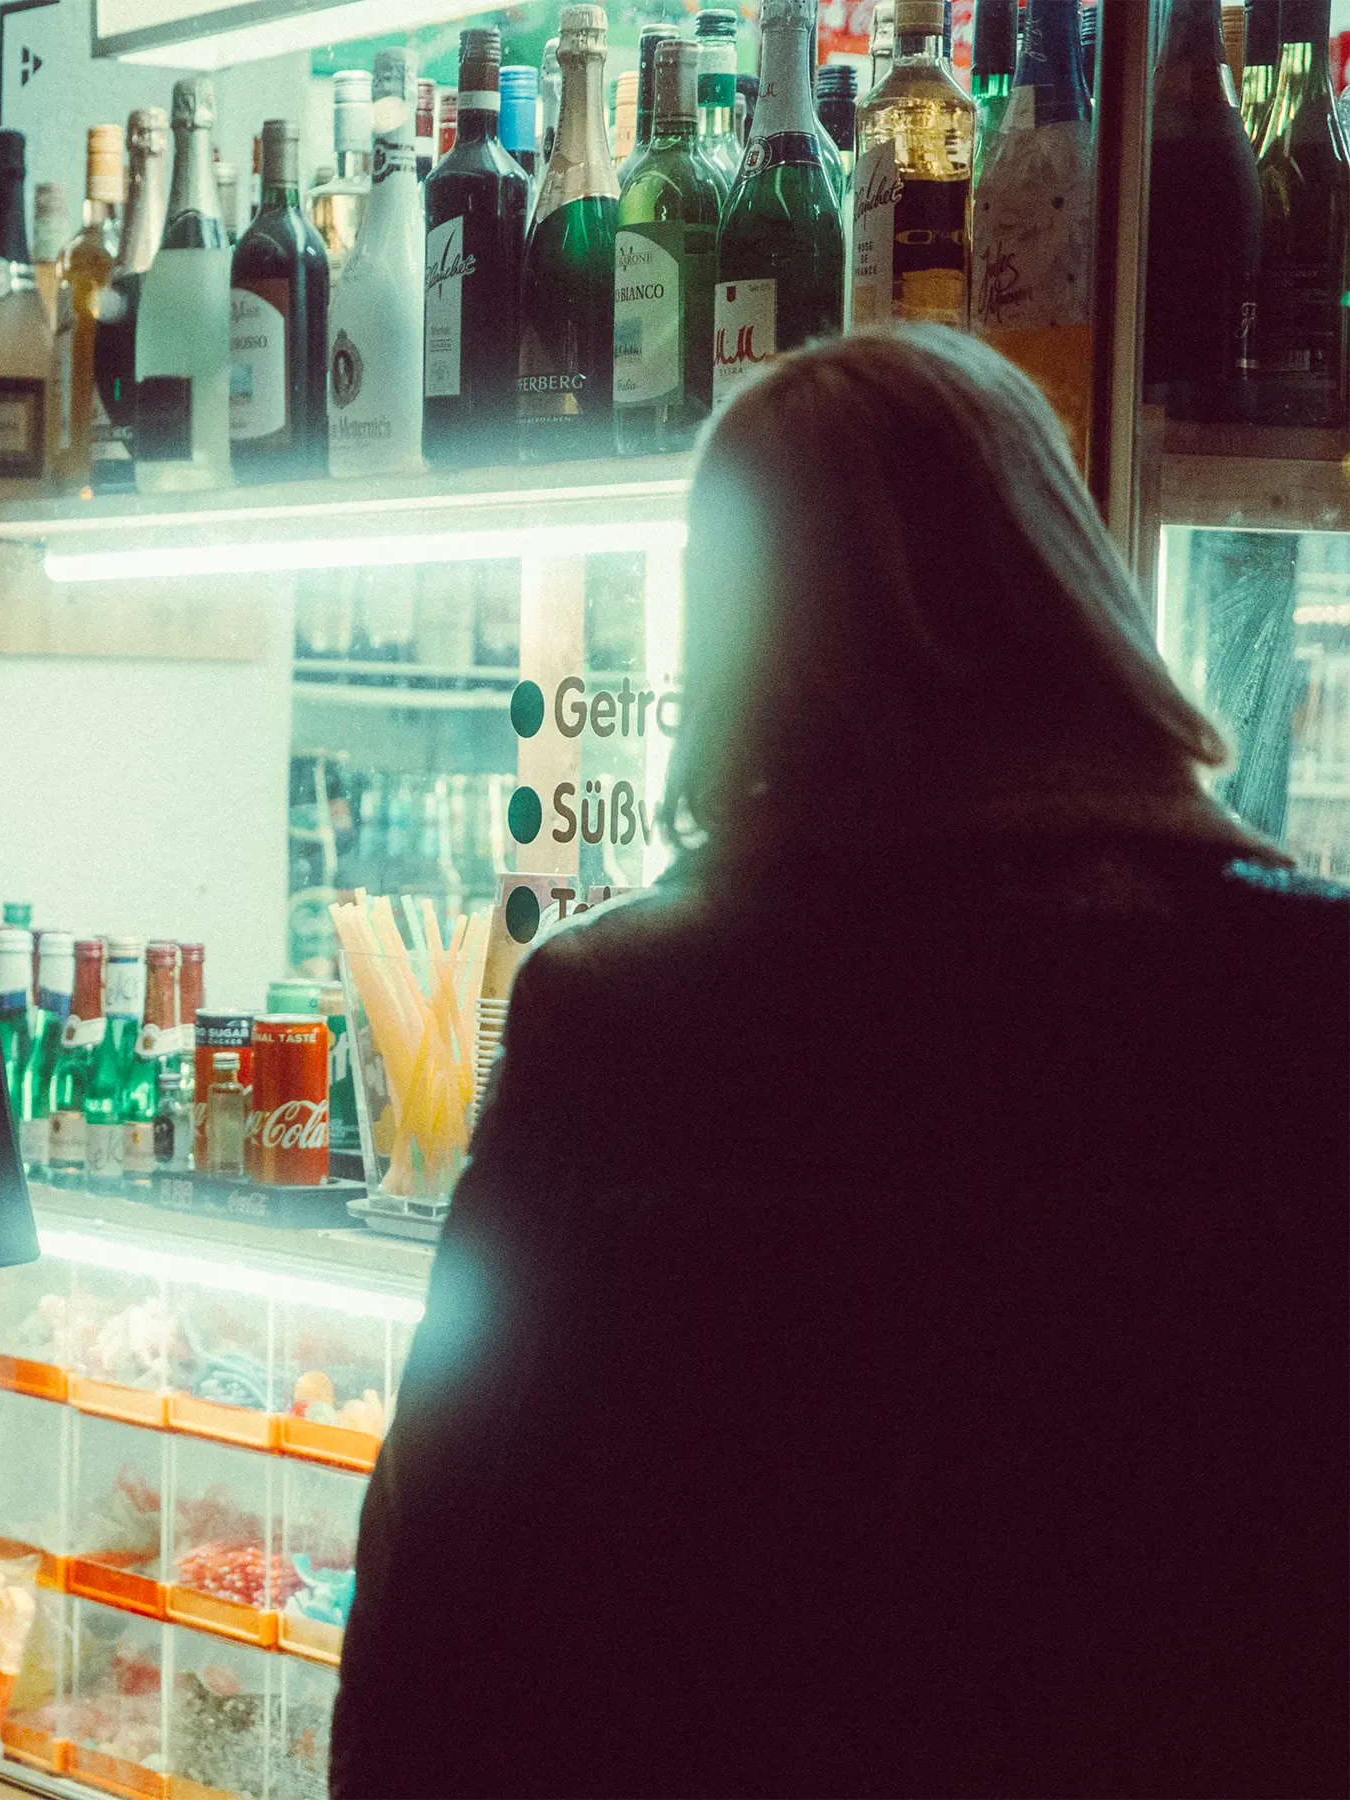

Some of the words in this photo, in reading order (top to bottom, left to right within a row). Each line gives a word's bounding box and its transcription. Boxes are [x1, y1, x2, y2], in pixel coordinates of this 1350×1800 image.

[620, 284, 664, 302] BIANCO
[209, 1028, 250, 1038] SUGAR
[278, 1033, 317, 1044] TASTE
